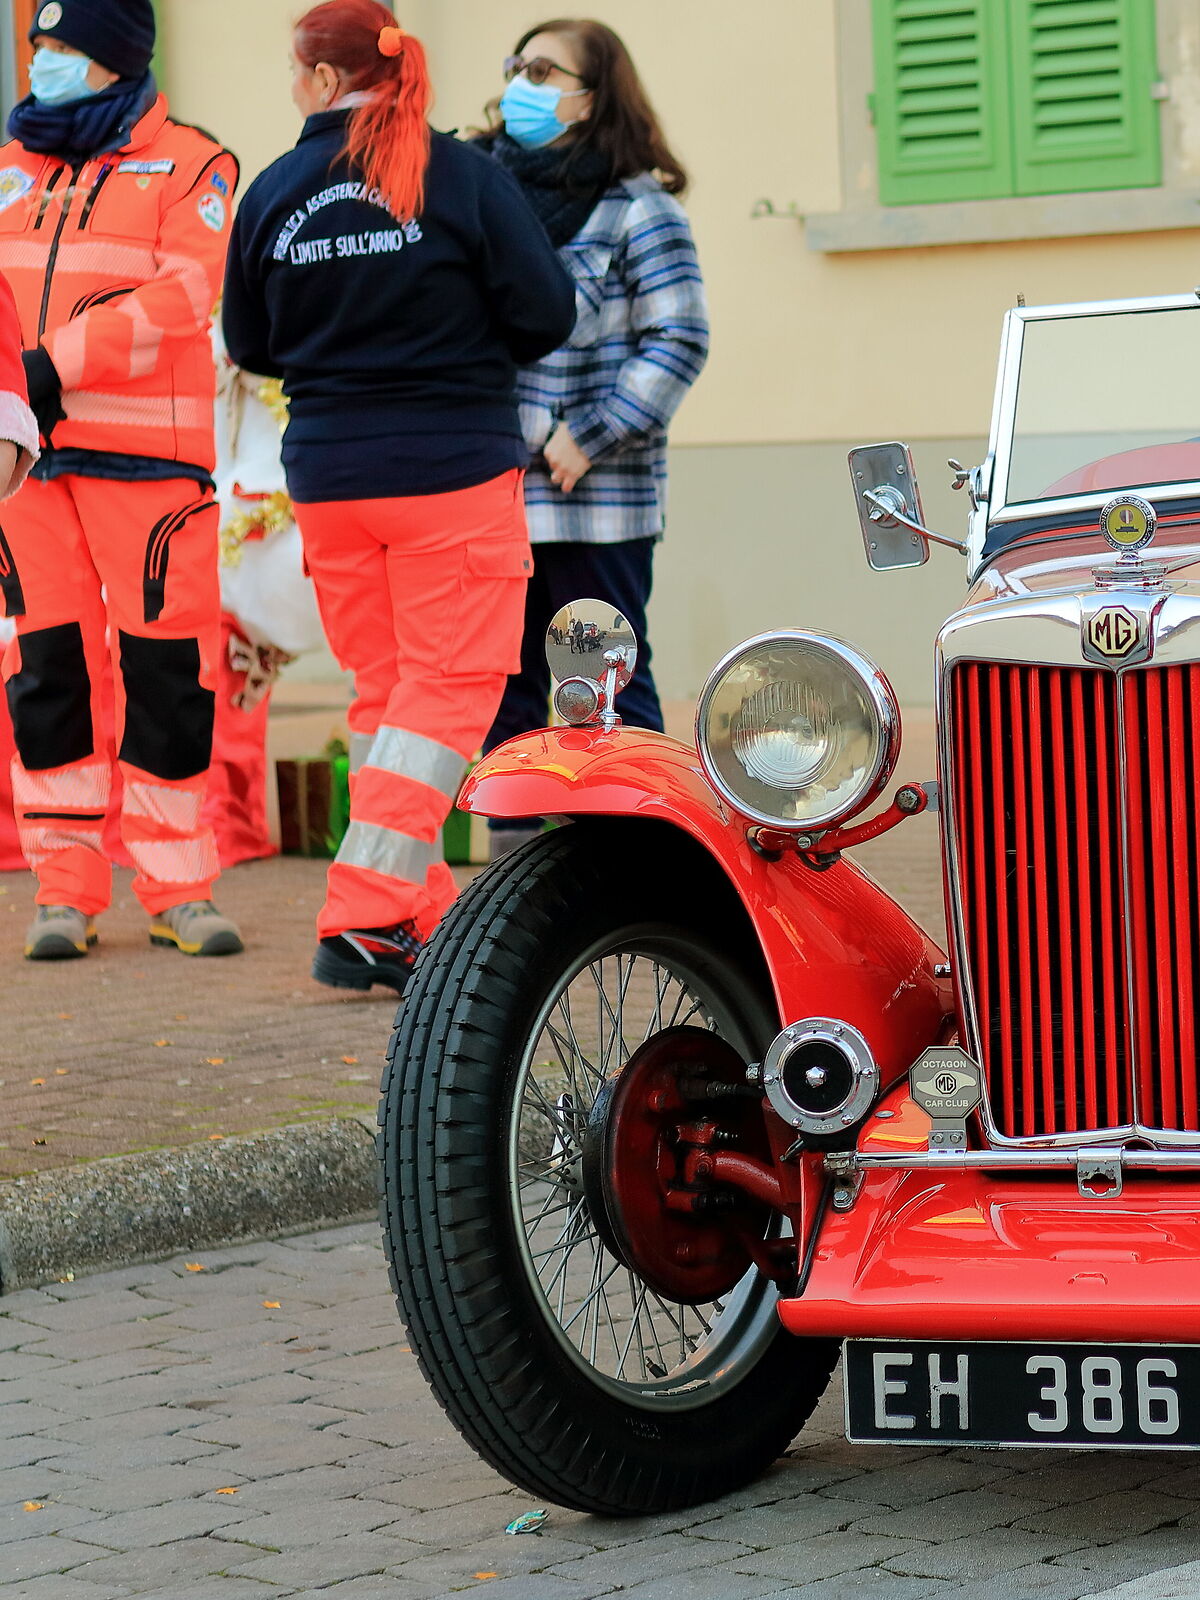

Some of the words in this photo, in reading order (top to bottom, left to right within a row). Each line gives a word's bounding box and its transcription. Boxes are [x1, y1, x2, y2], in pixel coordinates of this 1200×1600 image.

[306, 181, 367, 216] ASSISTENZA
[290, 239, 333, 265] LIMITE
[335, 229, 403, 257] SULL'ARNO
[1094, 612, 1132, 651] MG
[922, 1060, 967, 1069] OCTAGON
[938, 1076, 954, 1092] MG
[872, 1352, 970, 1430] EH
[1025, 1354, 1180, 1436] 386
